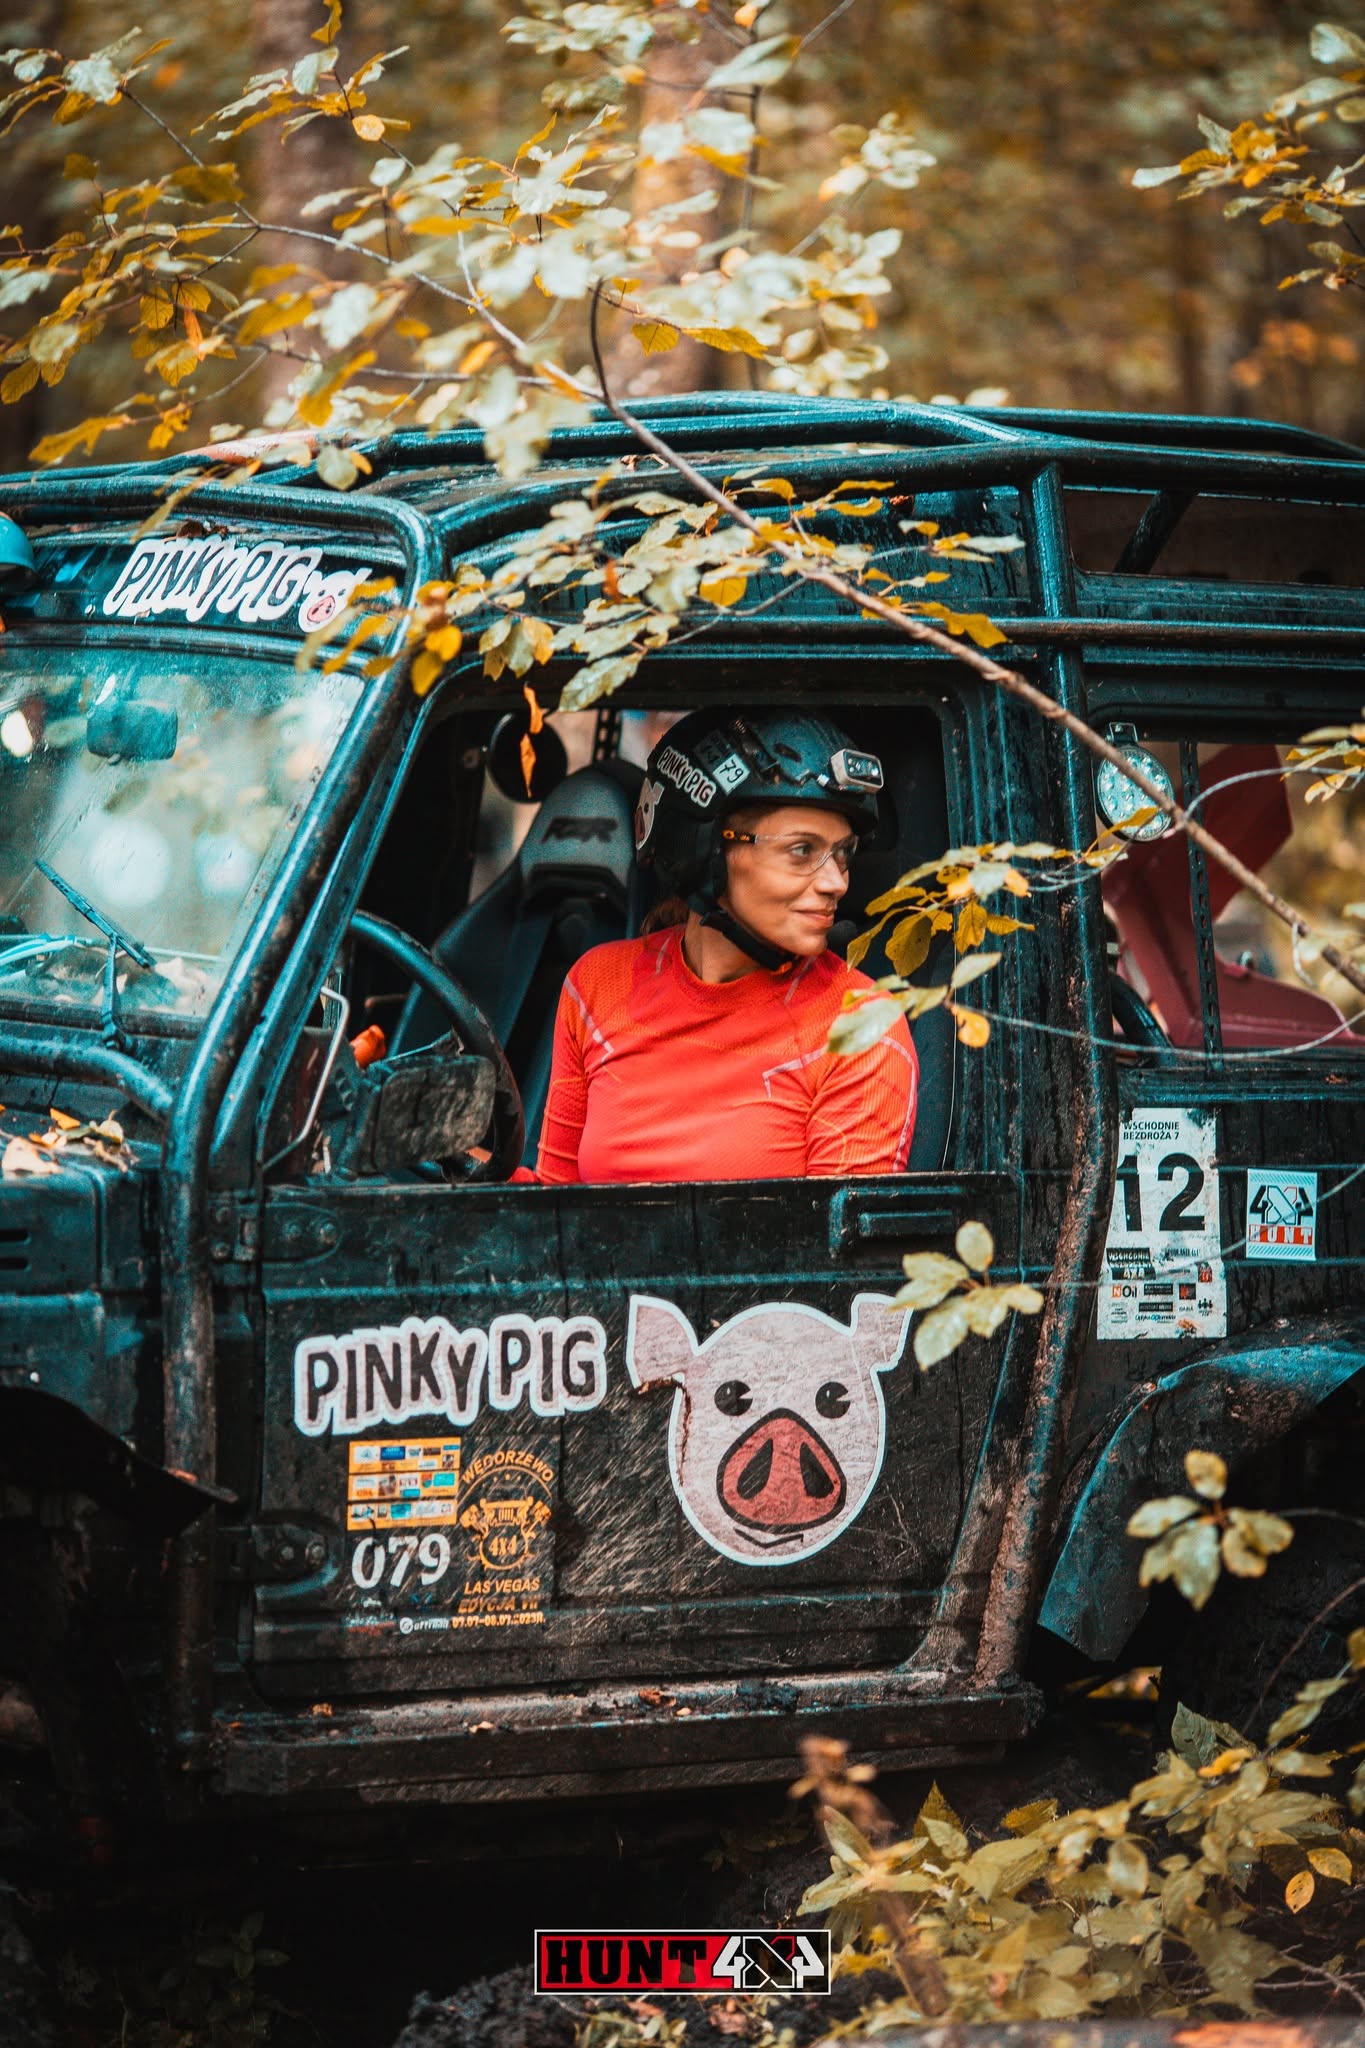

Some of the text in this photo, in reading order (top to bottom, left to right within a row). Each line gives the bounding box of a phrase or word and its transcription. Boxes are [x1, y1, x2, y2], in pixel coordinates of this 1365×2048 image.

[107, 543, 314, 614] PINKY PIG
[658, 748, 715, 804] PINKY PIG
[719, 759, 744, 784] 79
[1123, 1121, 1180, 1130] WSCHODNIE
[1174, 1131, 1180, 1140] 7
[1116, 1152, 1205, 1231] 12
[1249, 1225, 1312, 1245] HUNT
[303, 1326, 600, 1425] PINKY PIG
[352, 1533, 450, 1589] 079
[464, 1577, 541, 1595] LAS VEGAS
